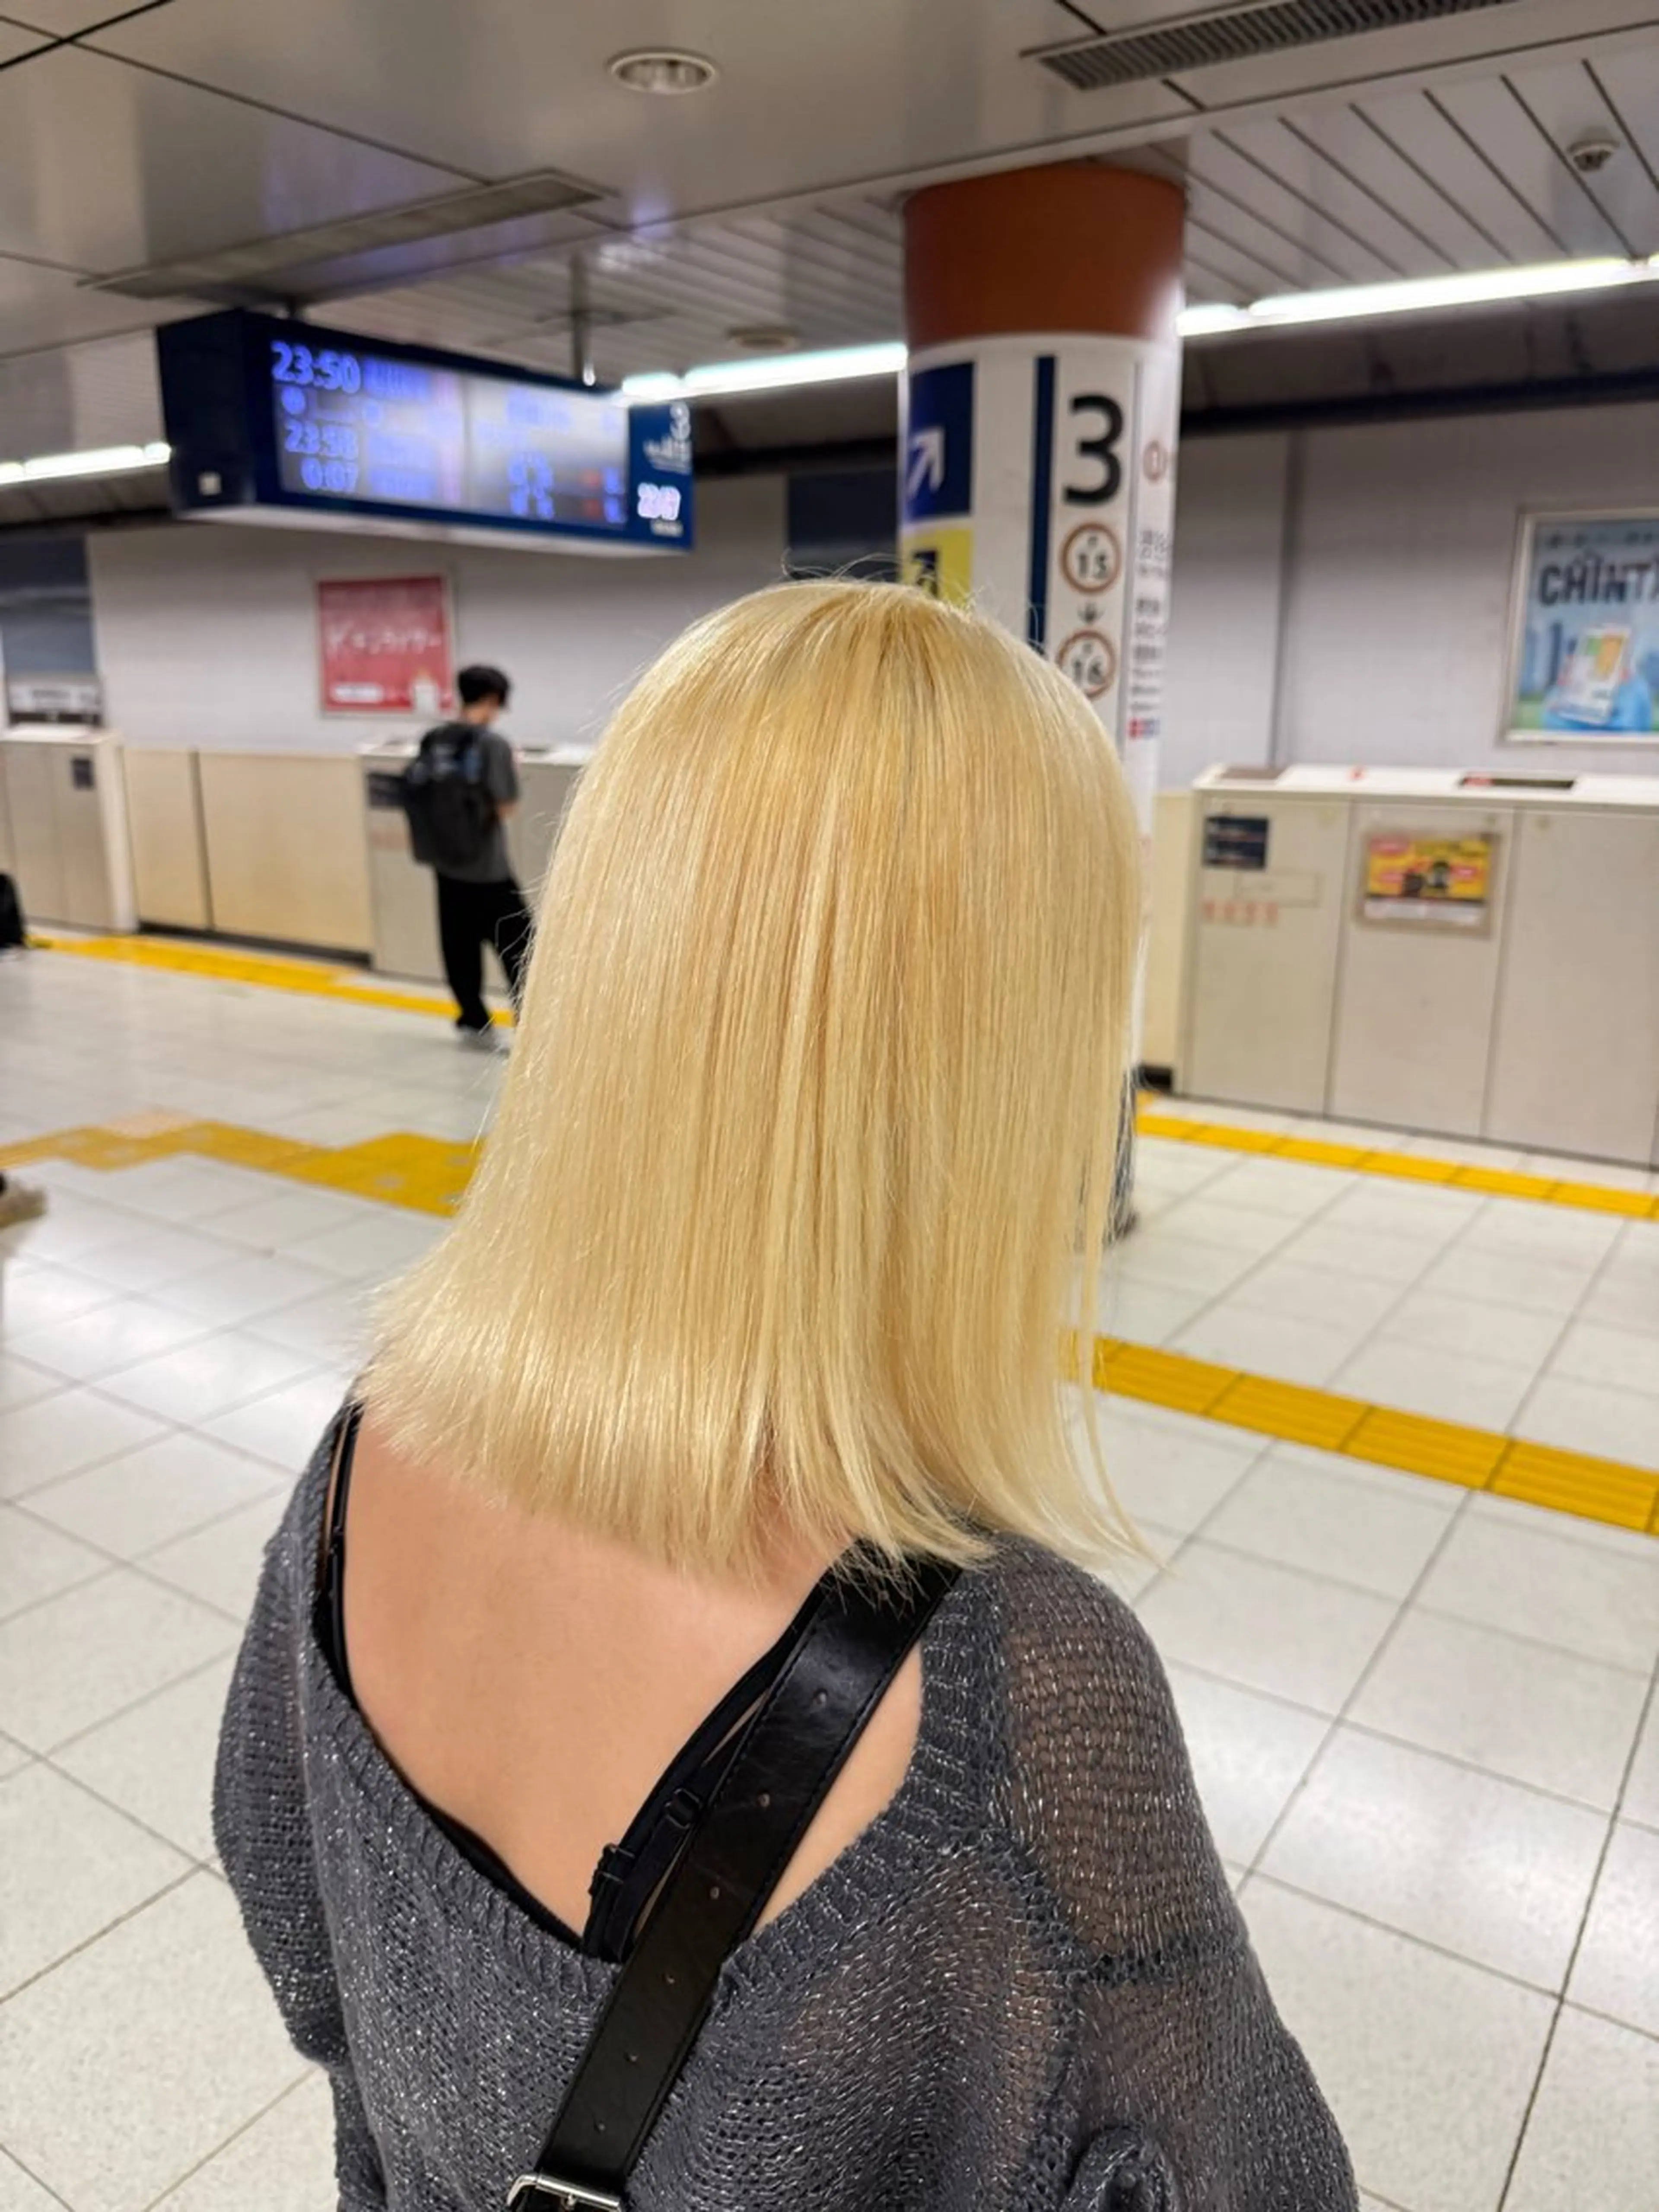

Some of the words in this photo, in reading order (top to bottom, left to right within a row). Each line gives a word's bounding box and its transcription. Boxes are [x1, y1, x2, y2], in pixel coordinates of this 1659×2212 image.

[271, 340, 361, 394] 23:50
[1062, 393, 1123, 505] 3
[1077, 551, 1109, 580] 15
